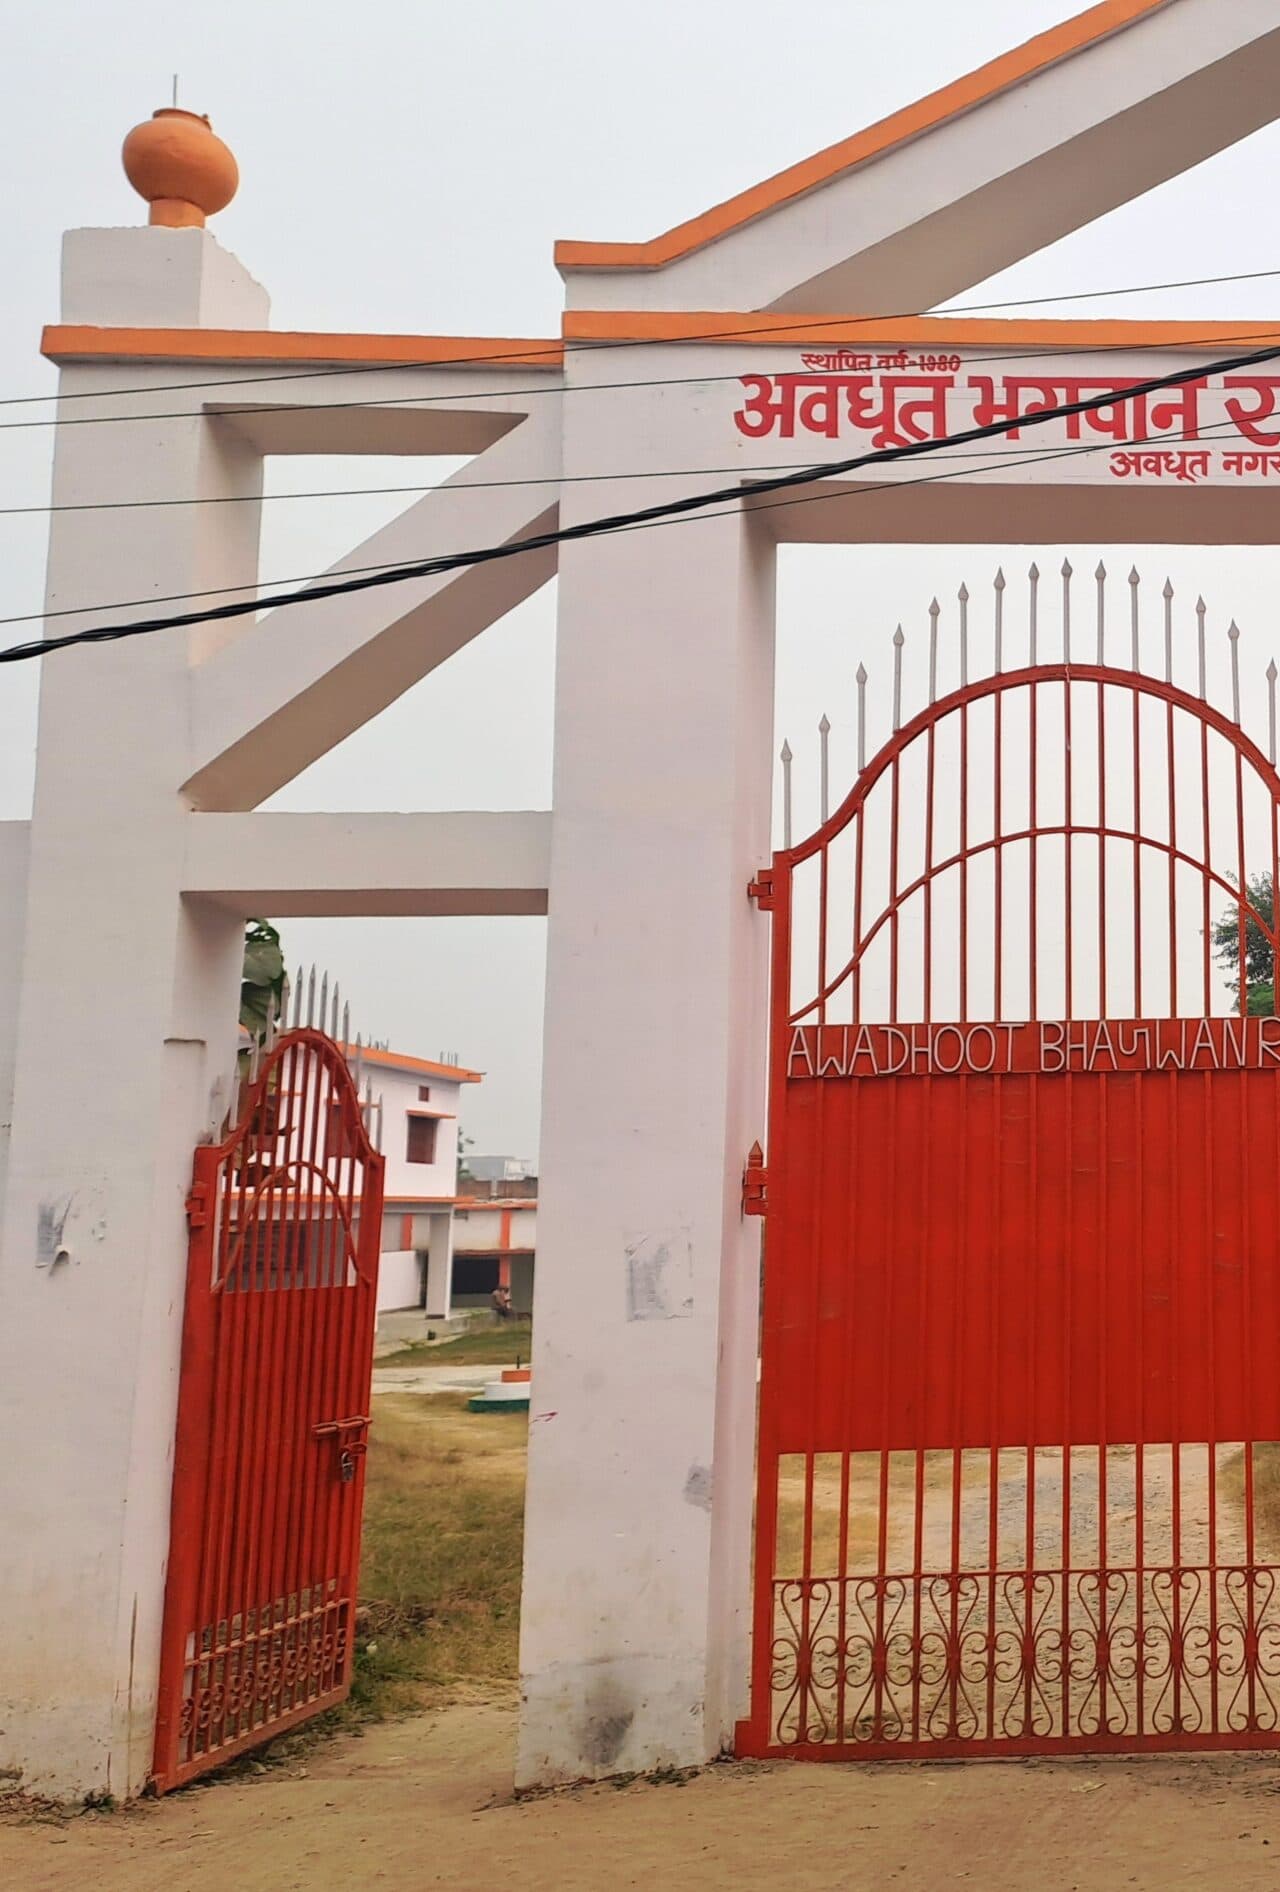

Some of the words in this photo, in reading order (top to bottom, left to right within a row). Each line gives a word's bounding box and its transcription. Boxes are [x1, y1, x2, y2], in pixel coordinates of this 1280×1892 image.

[801, 350, 872, 371] स्थापित
[733, 373, 955, 449] अवधूत
[968, 375, 1209, 441] भगवान
[786, 1023, 1025, 1077] AWADHOOT
